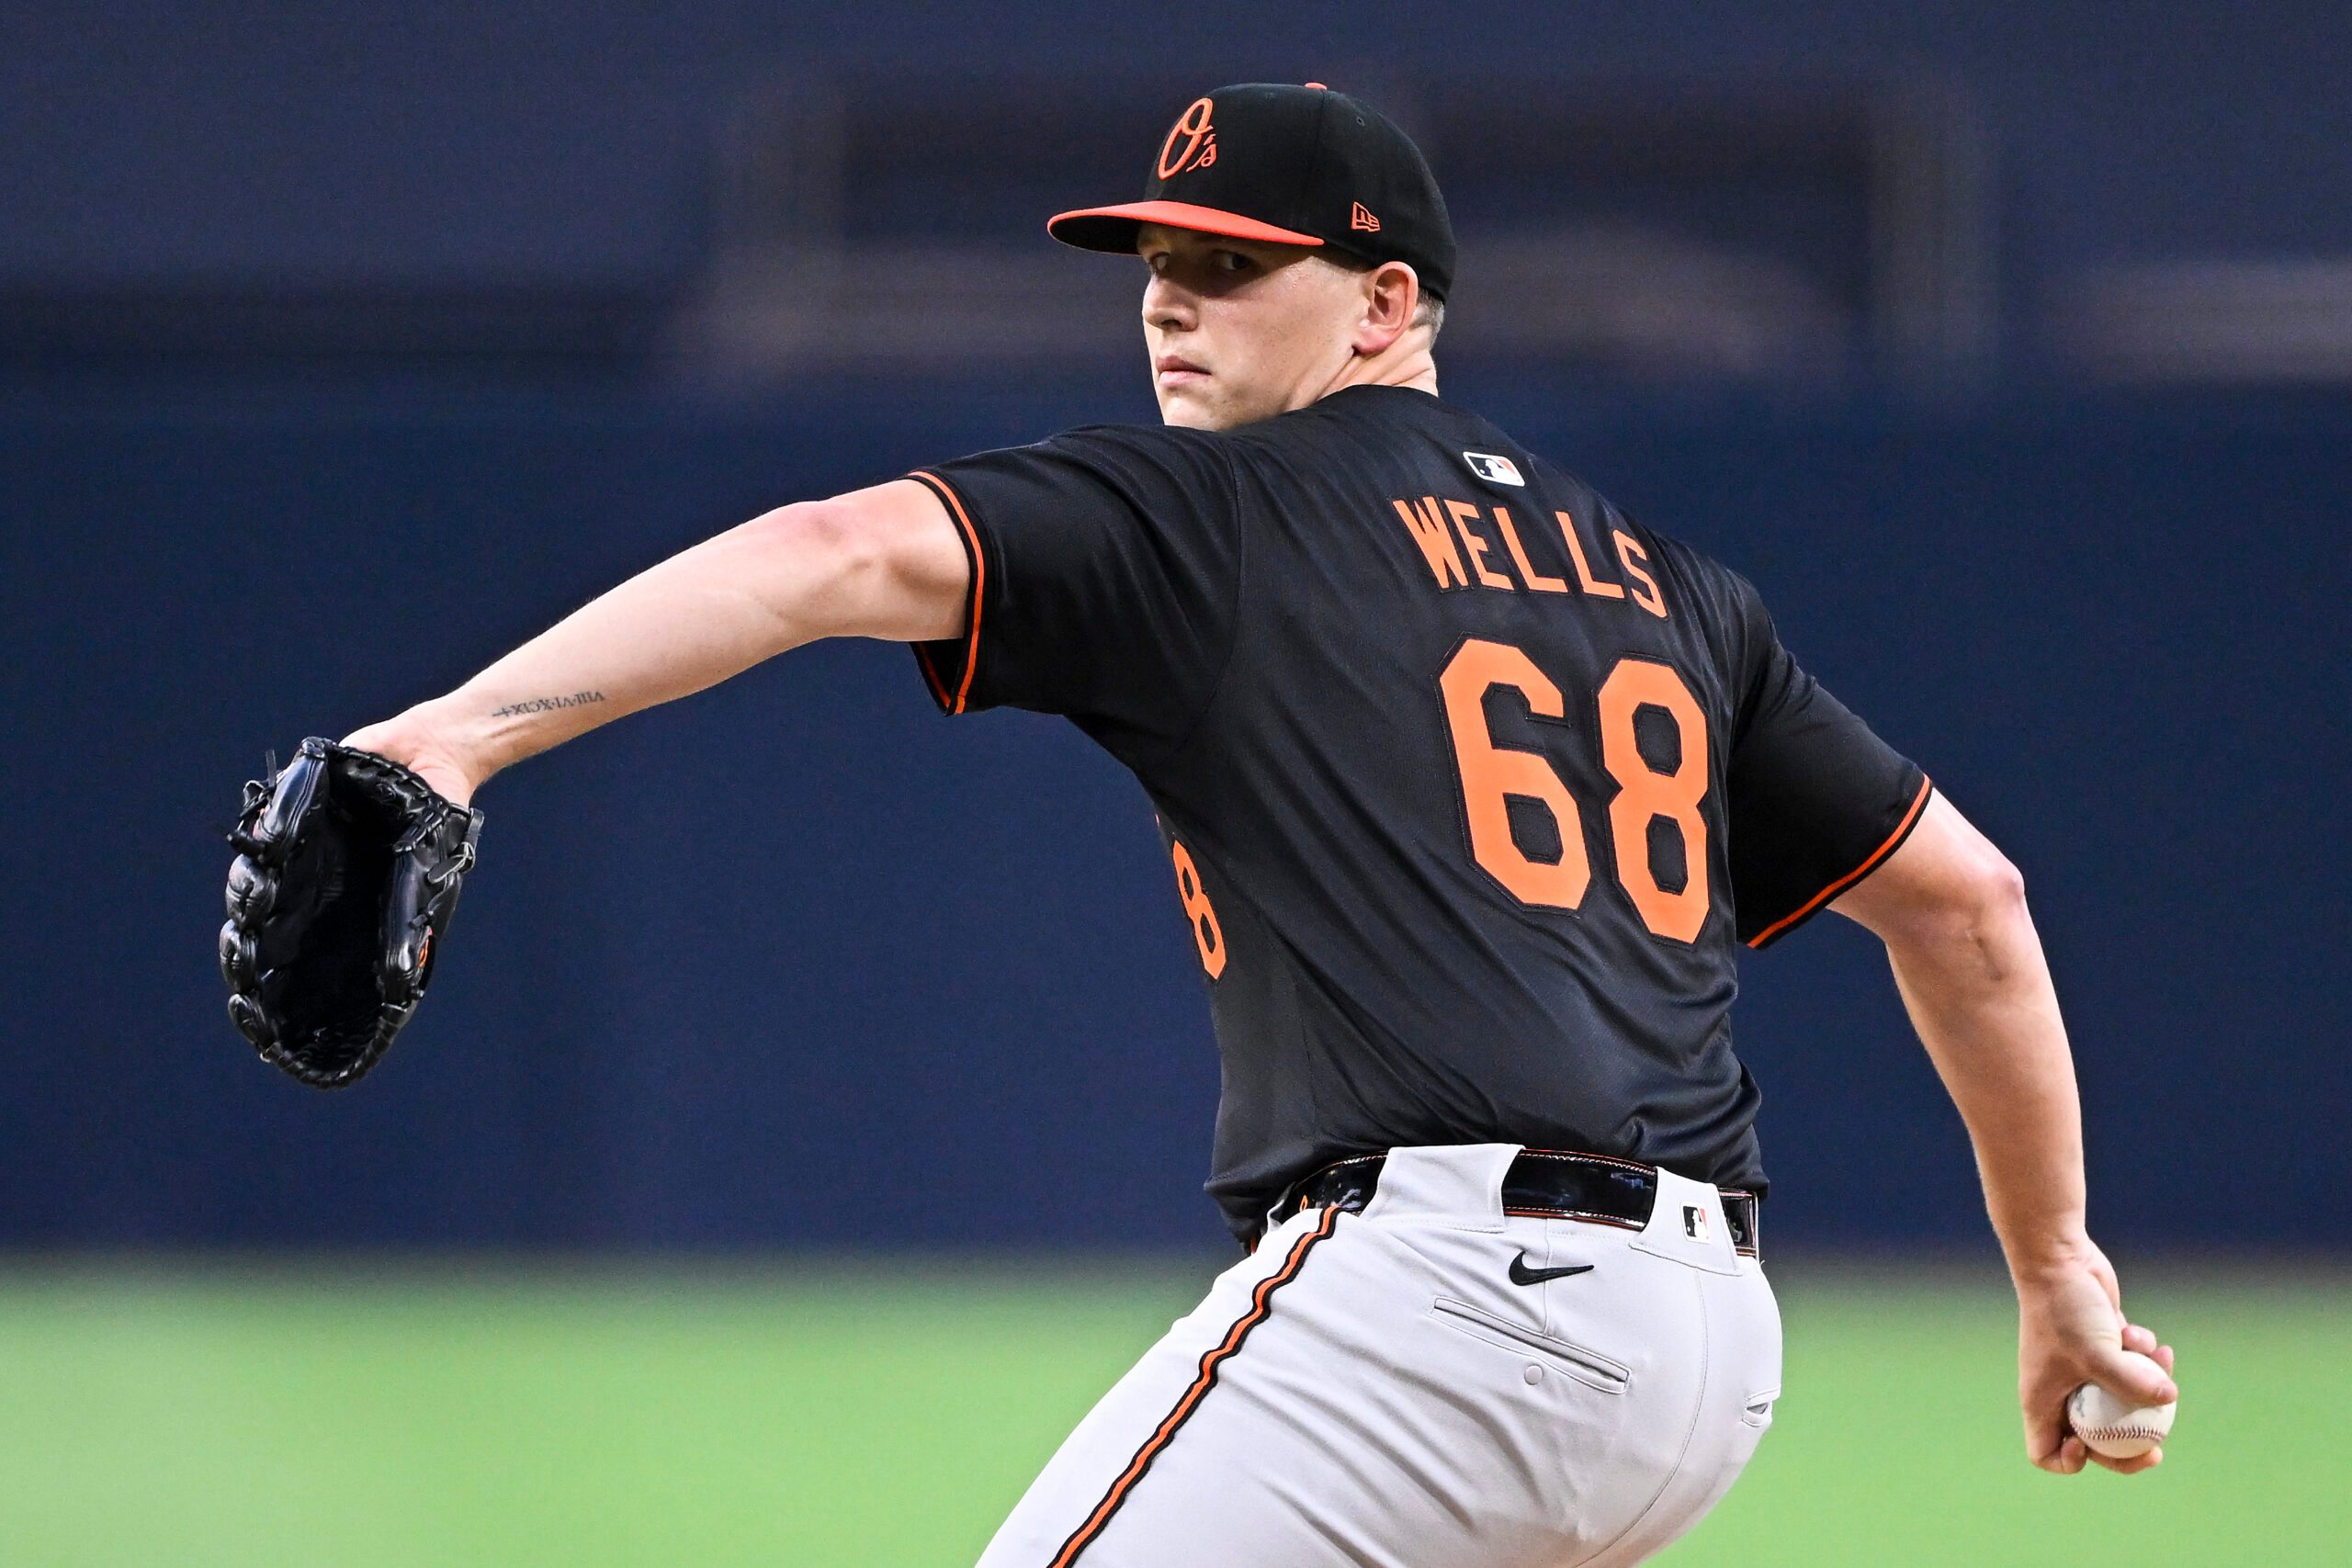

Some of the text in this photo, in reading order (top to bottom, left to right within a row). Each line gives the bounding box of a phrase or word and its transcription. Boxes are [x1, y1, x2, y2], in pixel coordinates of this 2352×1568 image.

[1158, 97, 1217, 181] O's
[1392, 496, 1668, 618] WELLS
[1439, 638, 1711, 945] 68
[1172, 840, 1227, 980] 8
